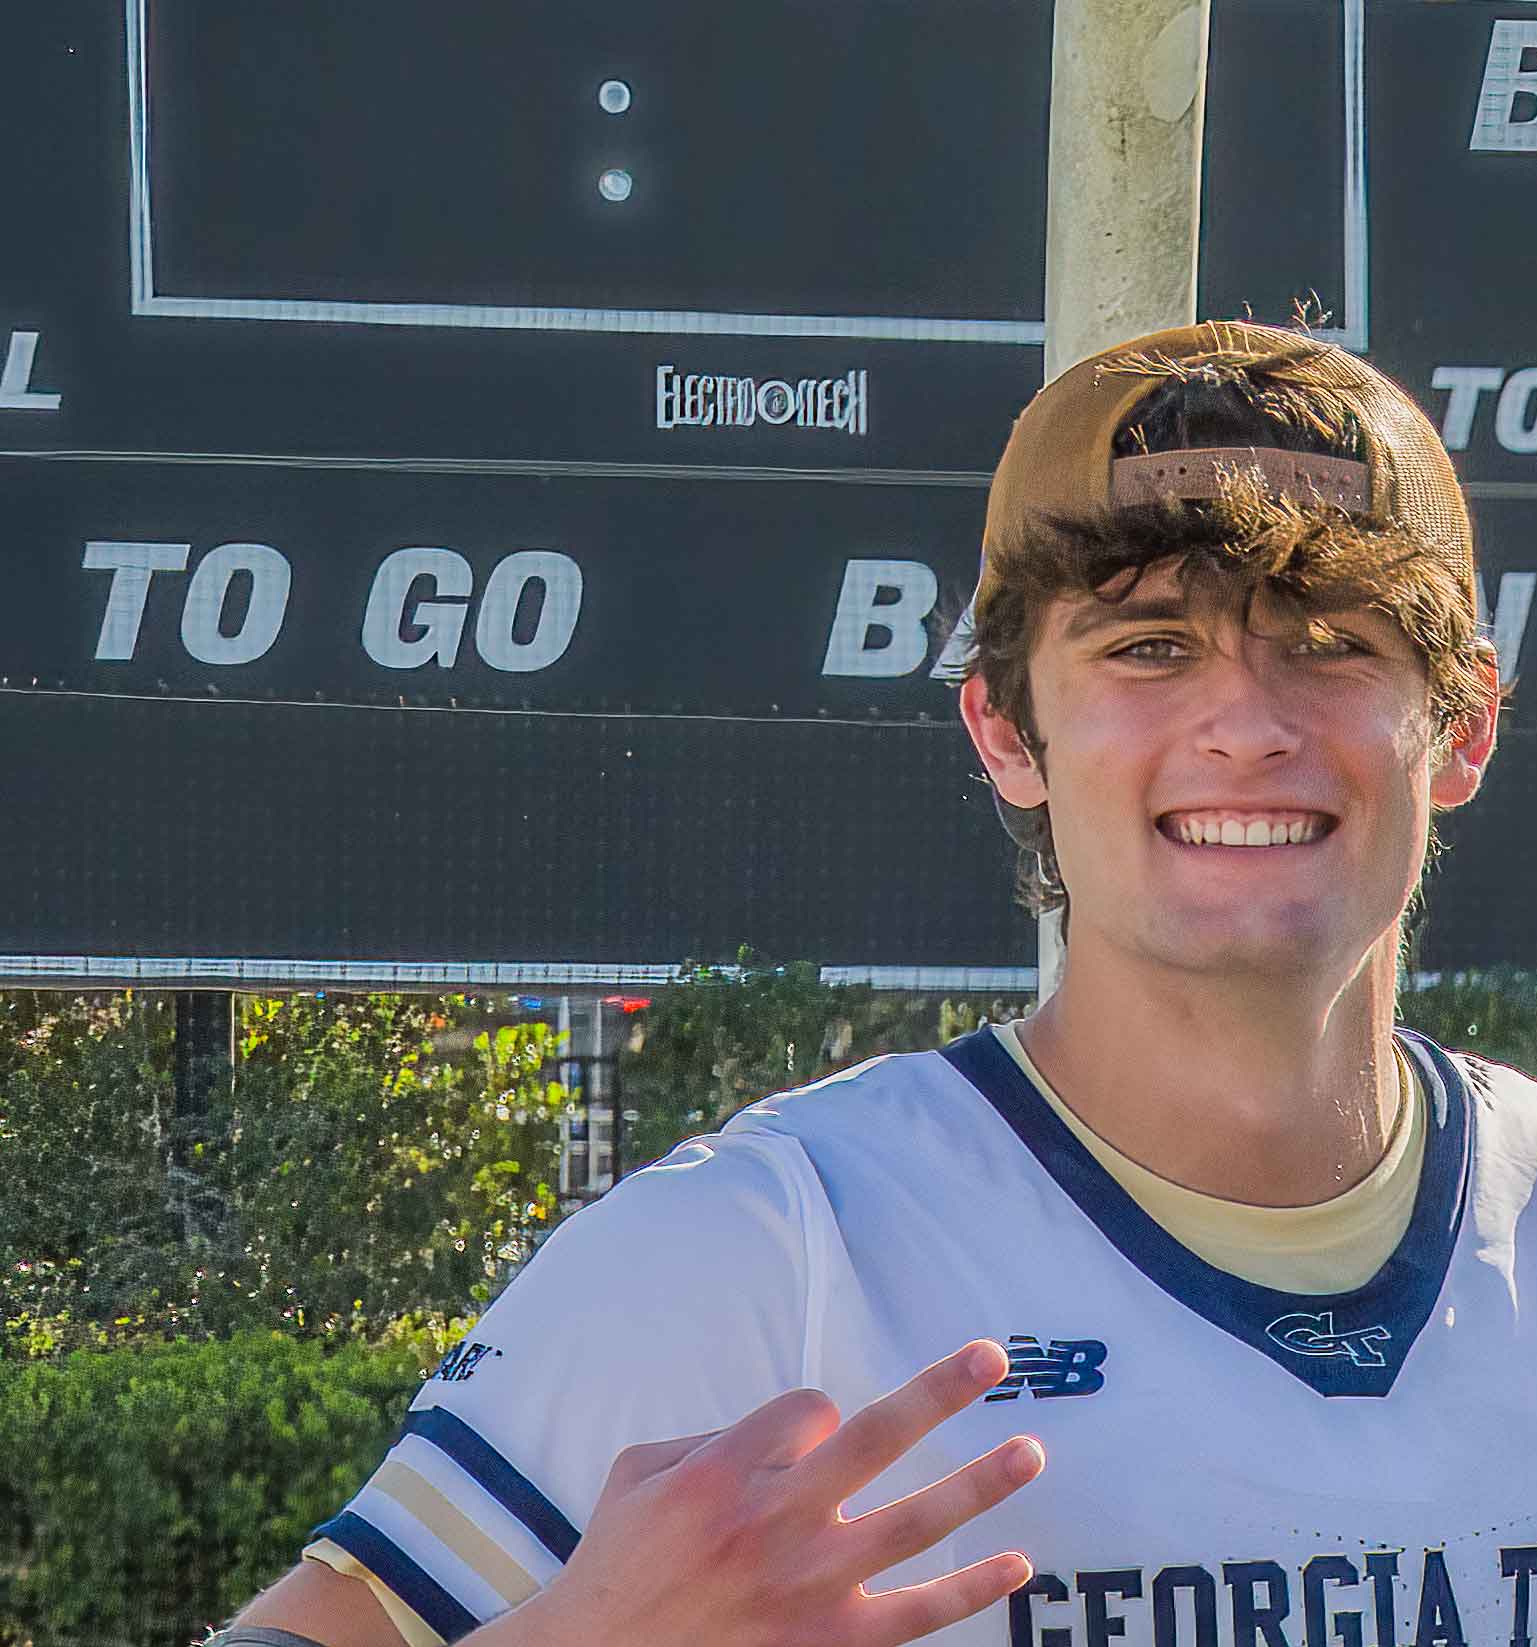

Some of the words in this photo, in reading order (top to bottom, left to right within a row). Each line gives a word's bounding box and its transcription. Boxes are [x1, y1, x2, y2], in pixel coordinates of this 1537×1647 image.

[82, 541, 292, 665] TO
[361, 547, 583, 672] GO
[1264, 1312, 1390, 1367] GT
